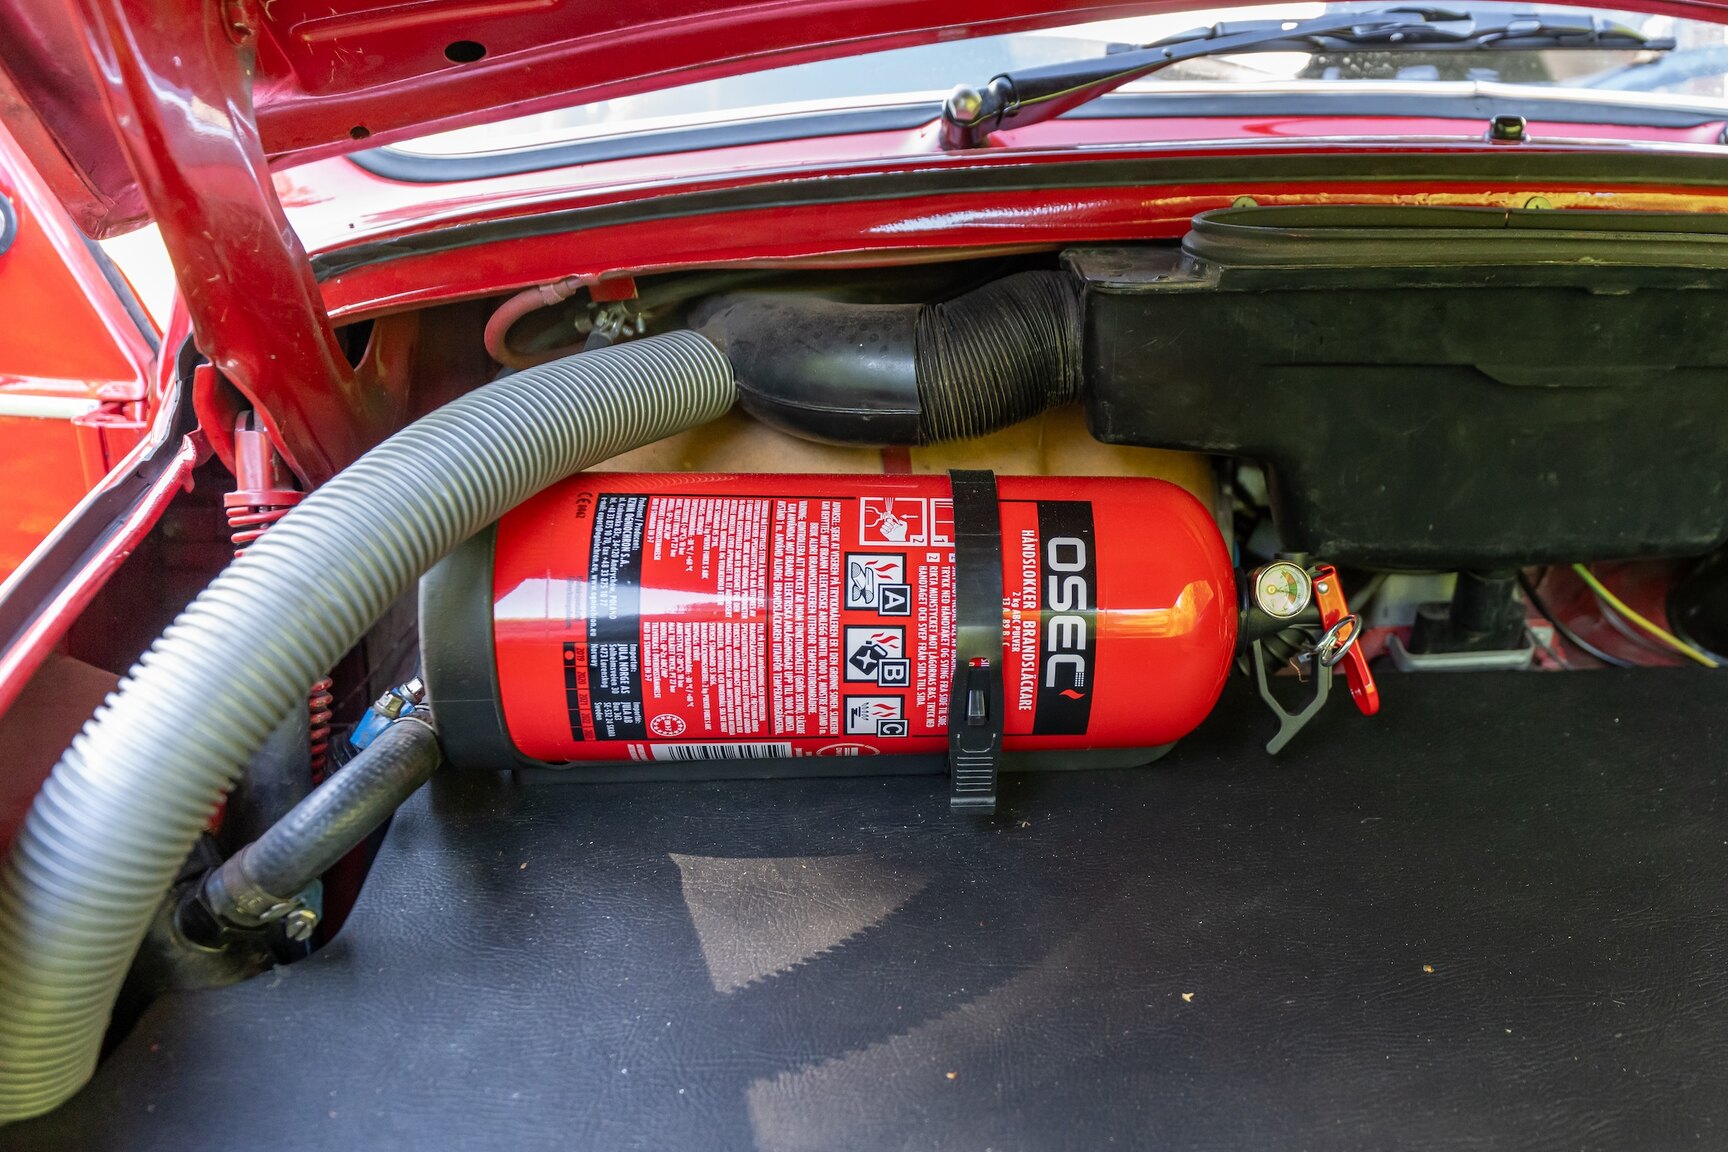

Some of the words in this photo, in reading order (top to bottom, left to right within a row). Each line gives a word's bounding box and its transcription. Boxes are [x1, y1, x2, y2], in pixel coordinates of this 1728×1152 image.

[613, 528, 621, 538] 83c,
[622, 513, 634, 552] OGNIOCHRON
[632, 523, 641, 550] Producent:
[603, 537, 612, 545] 70,
[786, 542, 794, 554] MOT
[809, 538, 818, 555] ALDRI
[820, 535, 829, 547] MOT
[603, 546, 611, 555] fax
[820, 548, 828, 568] BRANN
[620, 553, 630, 567] S.A.
[785, 556, 794, 576] BRAND
[796, 558, 805, 566] ATT
[831, 550, 839, 575] VISEREN
[774, 558, 782, 580] ALDRIG
[930, 566, 938, 586] RIKTA
[942, 566, 950, 587] TRYKK
[796, 568, 805, 593] TRYCKET
[808, 556, 818, 614] BRANNSLUKKEREN
[918, 566, 927, 605] HANDTAGET
[796, 594, 806, 602] ÄR
[819, 574, 828, 609] ELEKTRISKE
[941, 590, 950, 603] NED
[784, 582, 793, 619] ELEKTRISKA
[885, 591, 905, 609] A
[1003, 597, 1010, 605] 13
[1011, 598, 1020, 607] kg
[773, 582, 784, 641] BRANDSLÄCKAREN
[795, 604, 804, 620] INOM
[830, 587, 840, 637] TRYKKMÅLEREN
[918, 607, 926, 621] OCH
[928, 587, 938, 632] MUNSTYCKET
[1012, 609, 1020, 624] ABC
[1046, 537, 1087, 687] OSEC
[808, 616, 816, 644] UTENFOR
[819, 611, 828, 635] ANLEGG
[918, 623, 926, 639] SVEP
[941, 606, 952, 646] HÅNDTAKET
[1003, 619, 1010, 628] 89
[784, 620, 794, 670] ANLÄGGNINGAR
[928, 635, 937, 648] MOT
[1012, 626, 1020, 652] PULVER
[590, 644, 598, 666] Norway
[600, 644, 608, 658] 1473
[618, 644, 629, 660] JULA
[773, 643, 784, 671] UTANFÖR
[830, 652, 838, 665] DEN
[917, 643, 928, 660] FRÅN
[940, 648, 948, 657] OG
[609, 644, 618, 685] Solheimsveien
[819, 659, 827, 673] 1000
[917, 662, 926, 677] SIDA
[928, 652, 939, 685] LÅGORNAS
[940, 660, 948, 679] SVING
[1019, 620, 1036, 710] BRANDSLÄCKARE
[620, 662, 629, 684] NORGE
[784, 672, 793, 683] UPP
[885, 666, 904, 681] B
[784, 685, 793, 695] TILL
[917, 679, 925, 690] TILL
[939, 681, 948, 692] FRA
[917, 692, 925, 707] SIDA.
[927, 687, 936, 700] BAS.
[939, 694, 947, 706] SIDE
[620, 702, 631, 715] JULA
[927, 702, 935, 717] TRYCK
[883, 723, 903, 734] C
